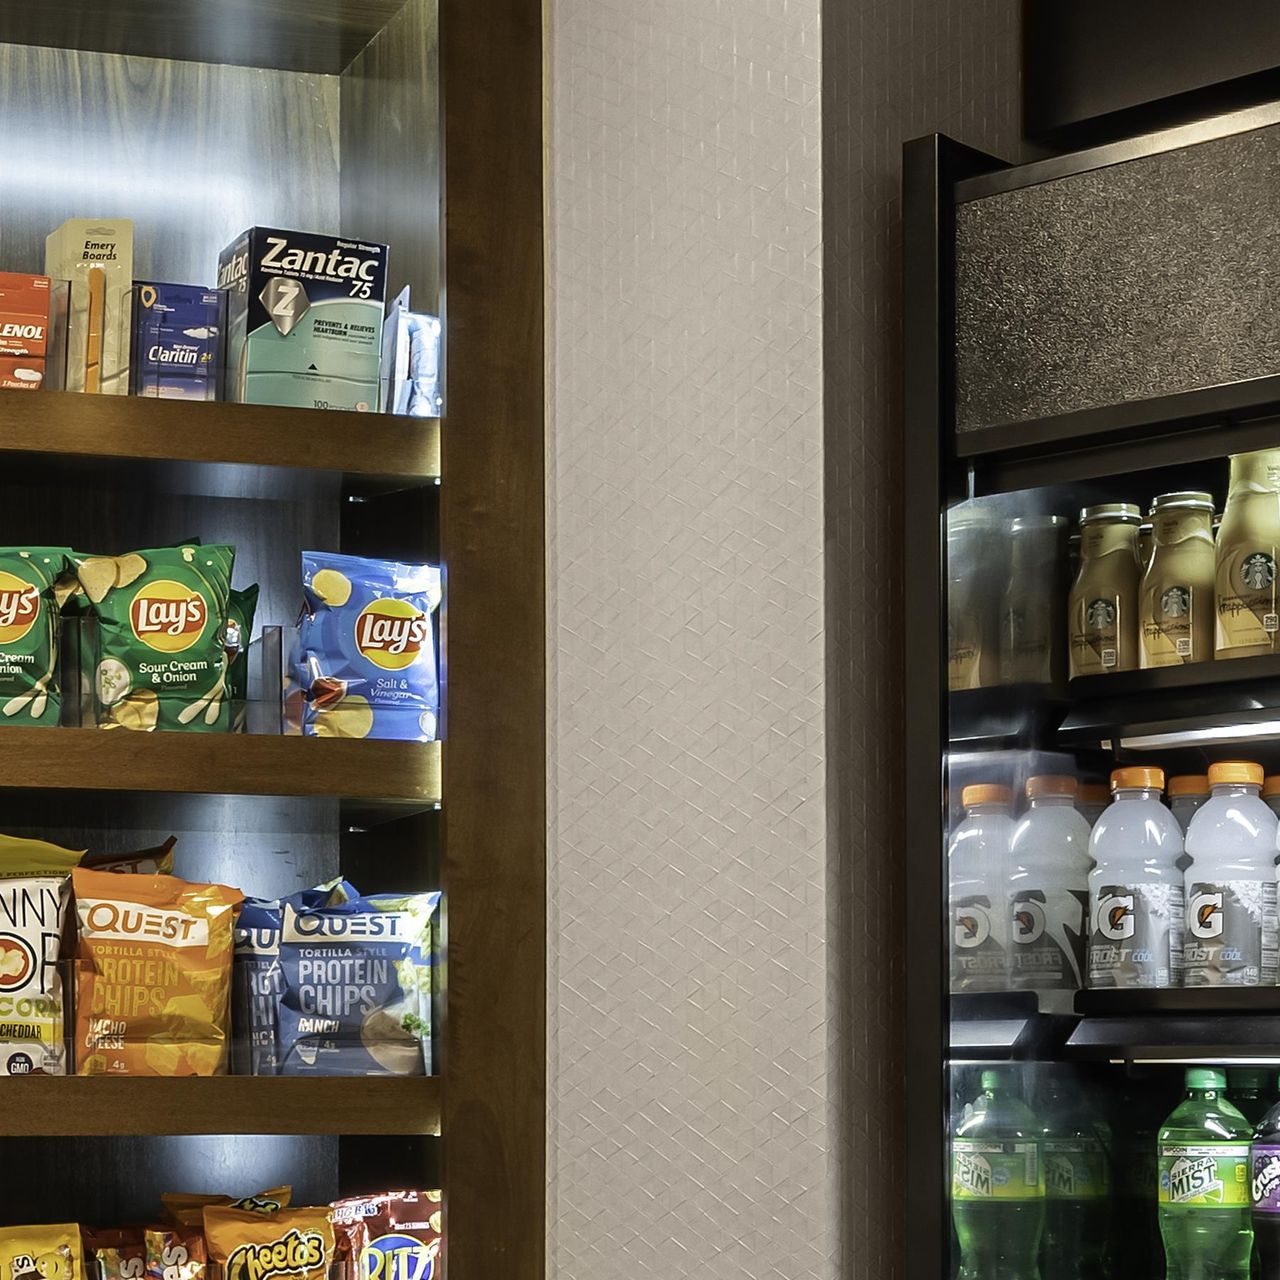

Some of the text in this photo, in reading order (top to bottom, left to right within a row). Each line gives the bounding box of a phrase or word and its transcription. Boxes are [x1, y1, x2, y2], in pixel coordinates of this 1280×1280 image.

[82, 250, 118, 262] Boards
[84, 241, 116, 252] Emery
[260, 237, 380, 281] Zantac
[348, 280, 372, 299] 75
[148, 344, 198, 364] Claritin
[138, 598, 201, 636] Lay's
[139, 660, 208, 674] Sour Cream
[151, 672, 197, 683] & Onion
[376, 678, 408, 688] Salt &
[87, 903, 198, 941] QUEST
[294, 914, 401, 937] QUEST
[299, 948, 388, 957] TORTILLA STYLE
[298, 959, 388, 985] PROTEIN
[299, 985, 376, 1016] CHIPS
[0, 1023, 42, 1039] CHEDDAR
[298, 1018, 340, 1034] RANCH
[11, 1062, 30, 1073] GMO
[1170, 1156, 1216, 1179] SIERRA
[1170, 1166, 1218, 1200] MIST
